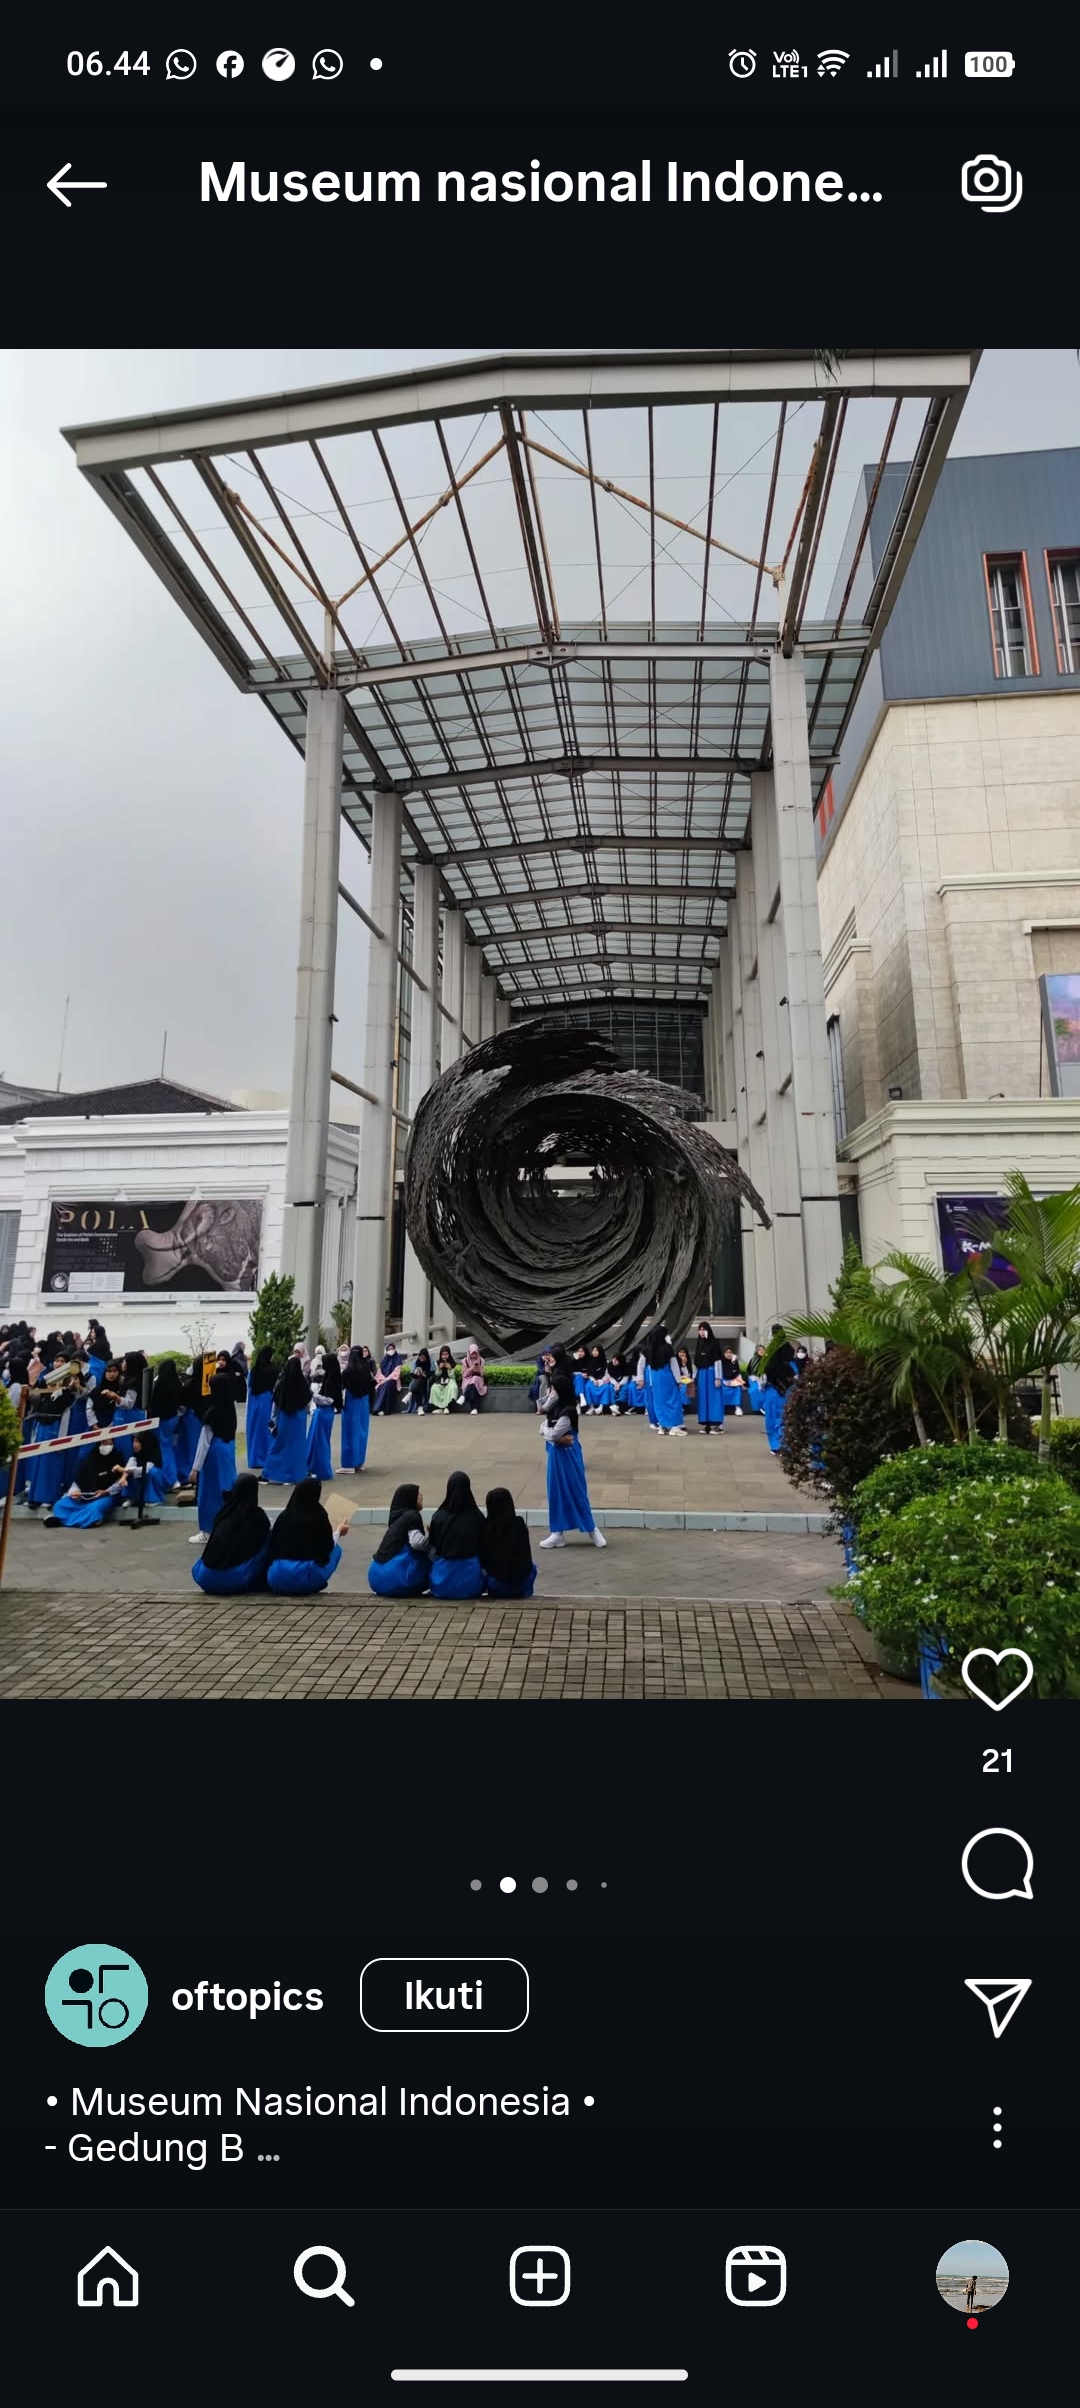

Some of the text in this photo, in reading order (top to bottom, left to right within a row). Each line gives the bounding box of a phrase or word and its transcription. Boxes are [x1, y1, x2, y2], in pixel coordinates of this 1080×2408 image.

[66, 50, 151, 77] 06.44
[970, 55, 1007, 73] 100
[200, 161, 421, 203] Museum
[437, 158, 651, 203] nasional
[982, 1748, 1012, 1773] 21
[171, 1980, 324, 2020] oftopics
[406, 1979, 483, 2010] Ikuti
[72, 2087, 222, 2116] Museum
[236, 2085, 387, 2116] Nasional
[400, 2085, 570, 2116] Indonesia
[68, 2131, 207, 2171] Gedung
[221, 2133, 244, 2162] B
